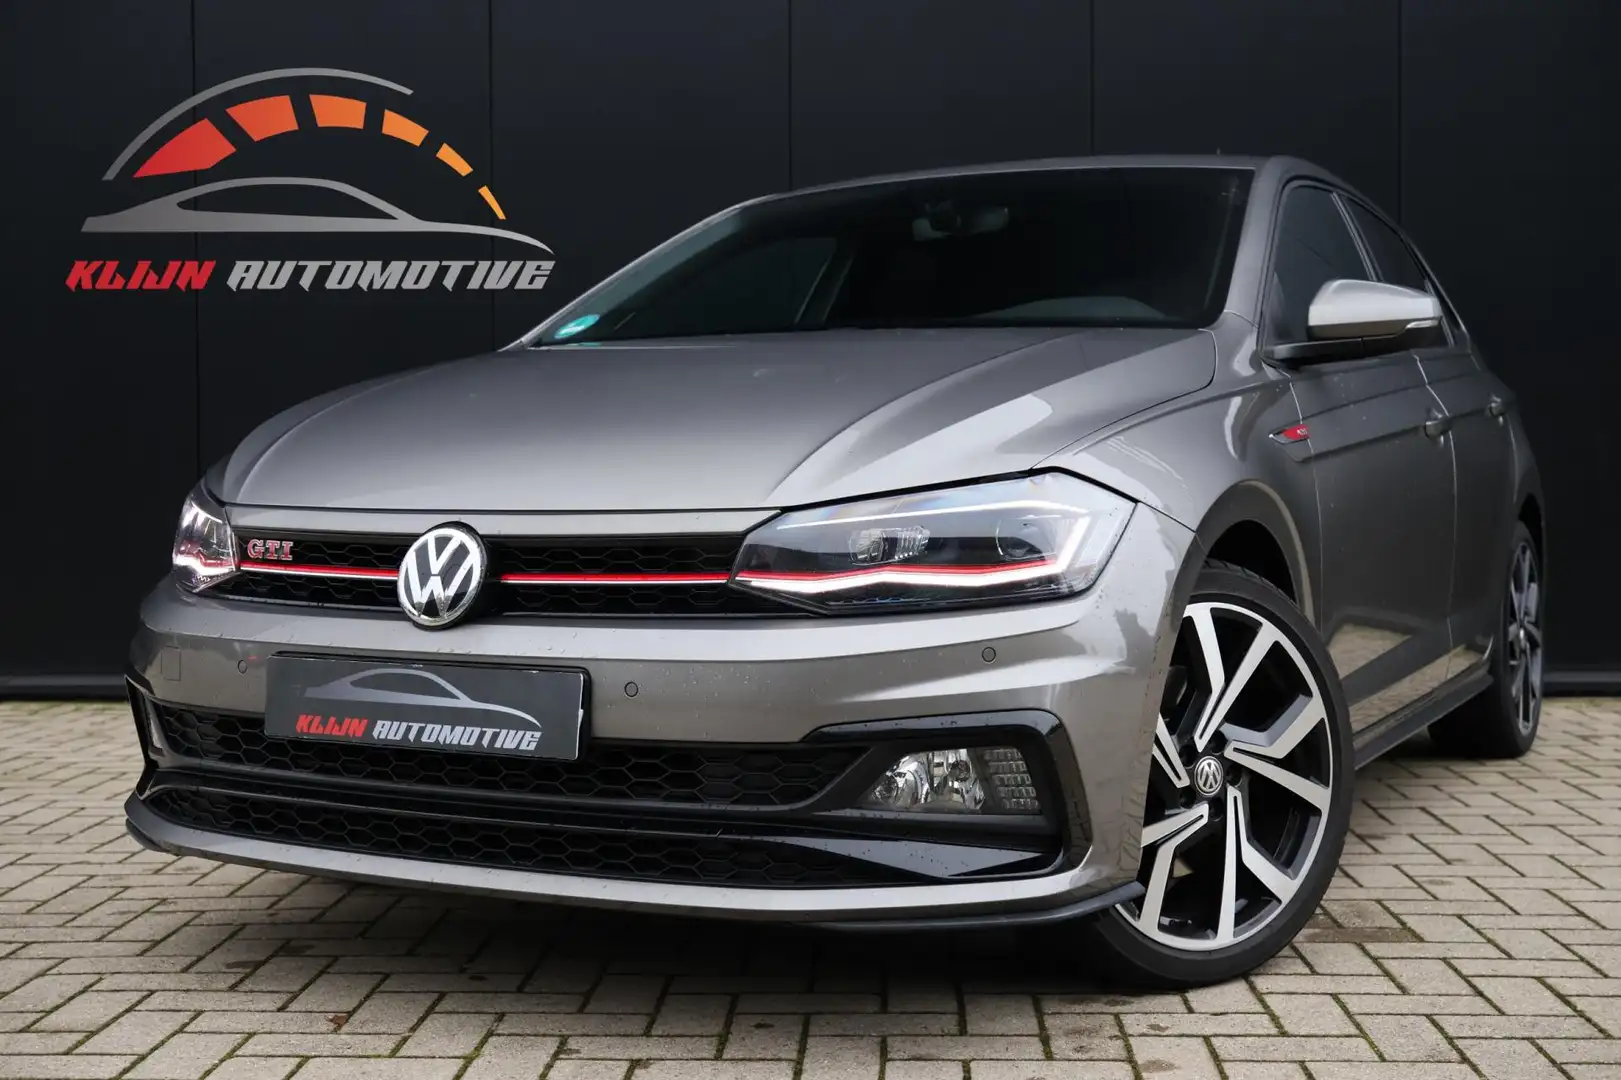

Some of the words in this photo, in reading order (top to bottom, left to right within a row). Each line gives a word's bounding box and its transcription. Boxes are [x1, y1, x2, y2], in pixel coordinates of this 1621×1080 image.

[65, 260, 216, 293] KLIJN
[226, 260, 556, 293] AUTOMOTIVE
[247, 538, 294, 561] GTI
[296, 714, 368, 738] KLIJN
[372, 719, 542, 750] AUTOMOTIVE
